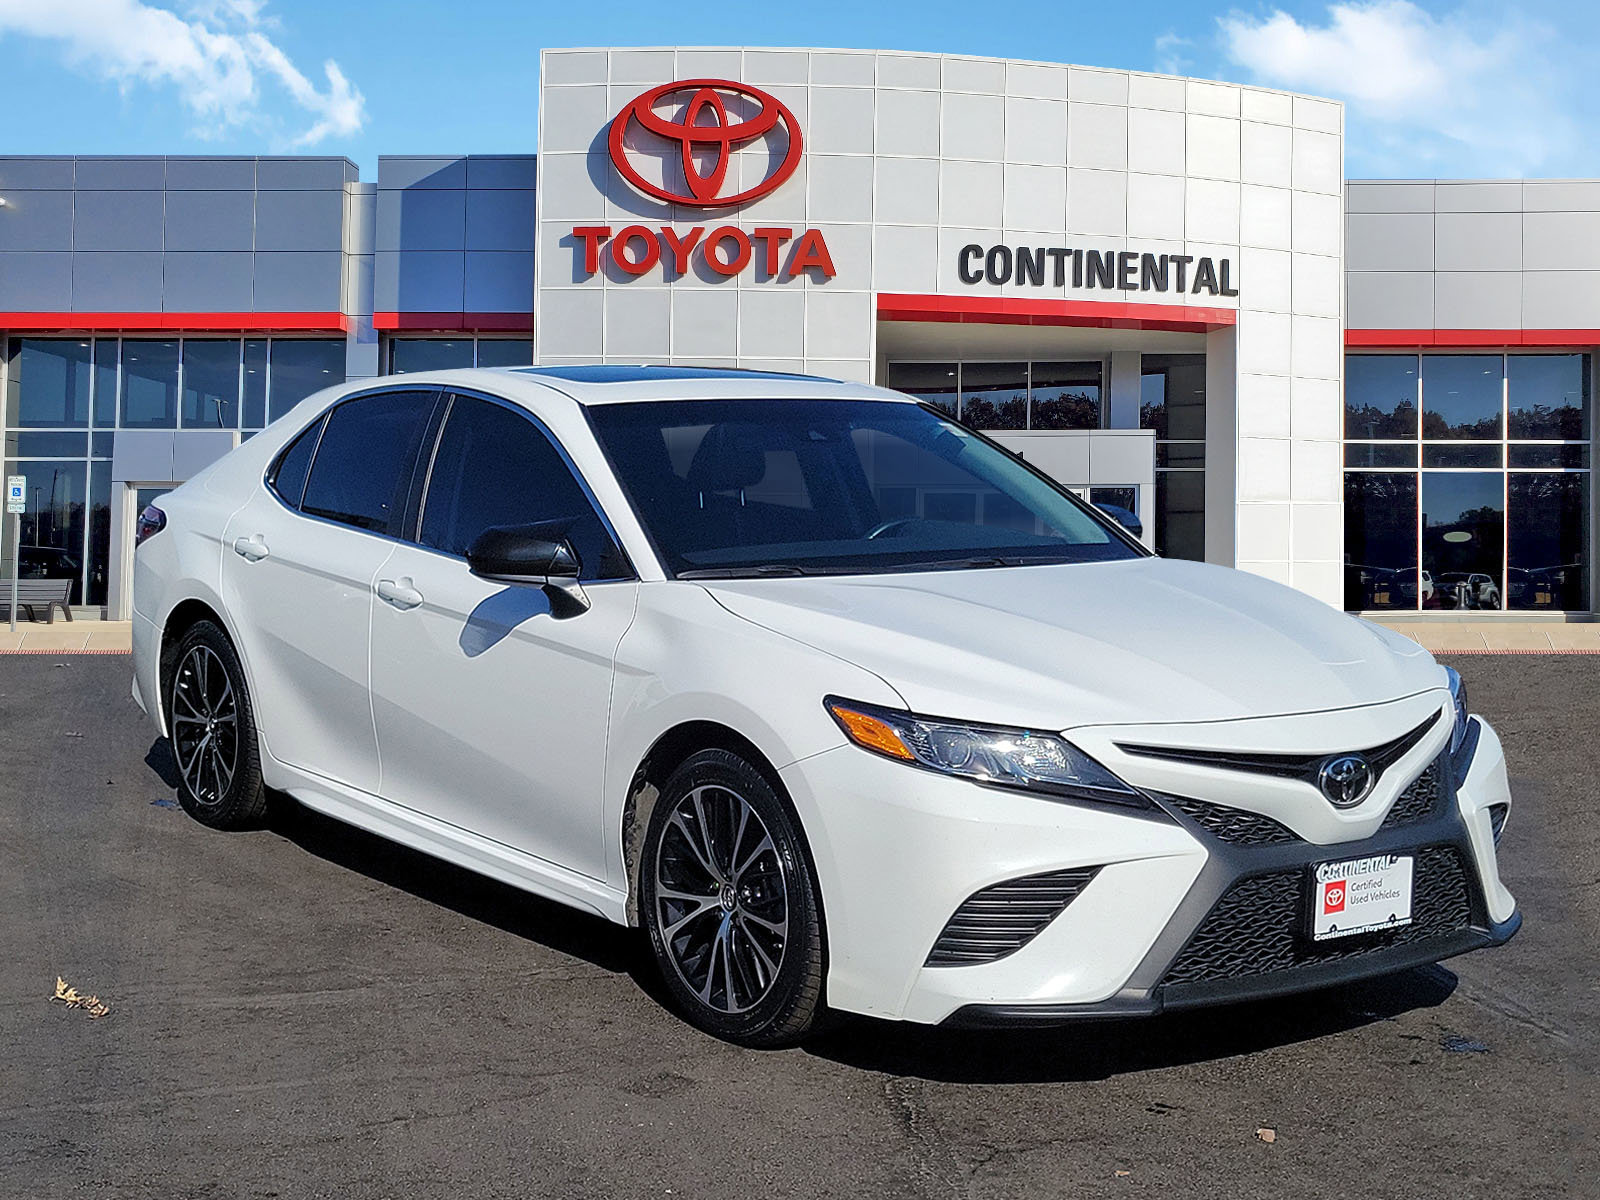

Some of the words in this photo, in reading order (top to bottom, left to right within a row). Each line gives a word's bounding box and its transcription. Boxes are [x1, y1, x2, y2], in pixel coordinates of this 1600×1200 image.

[573, 225, 837, 277] TOYOTA
[959, 244, 1239, 296] CONTINENTAL
[1317, 854, 1391, 881] CONTINENTAL
[1350, 895, 1369, 905] Used
[1370, 889, 1401, 902] Vehicles
[1351, 878, 1383, 892] Certified
